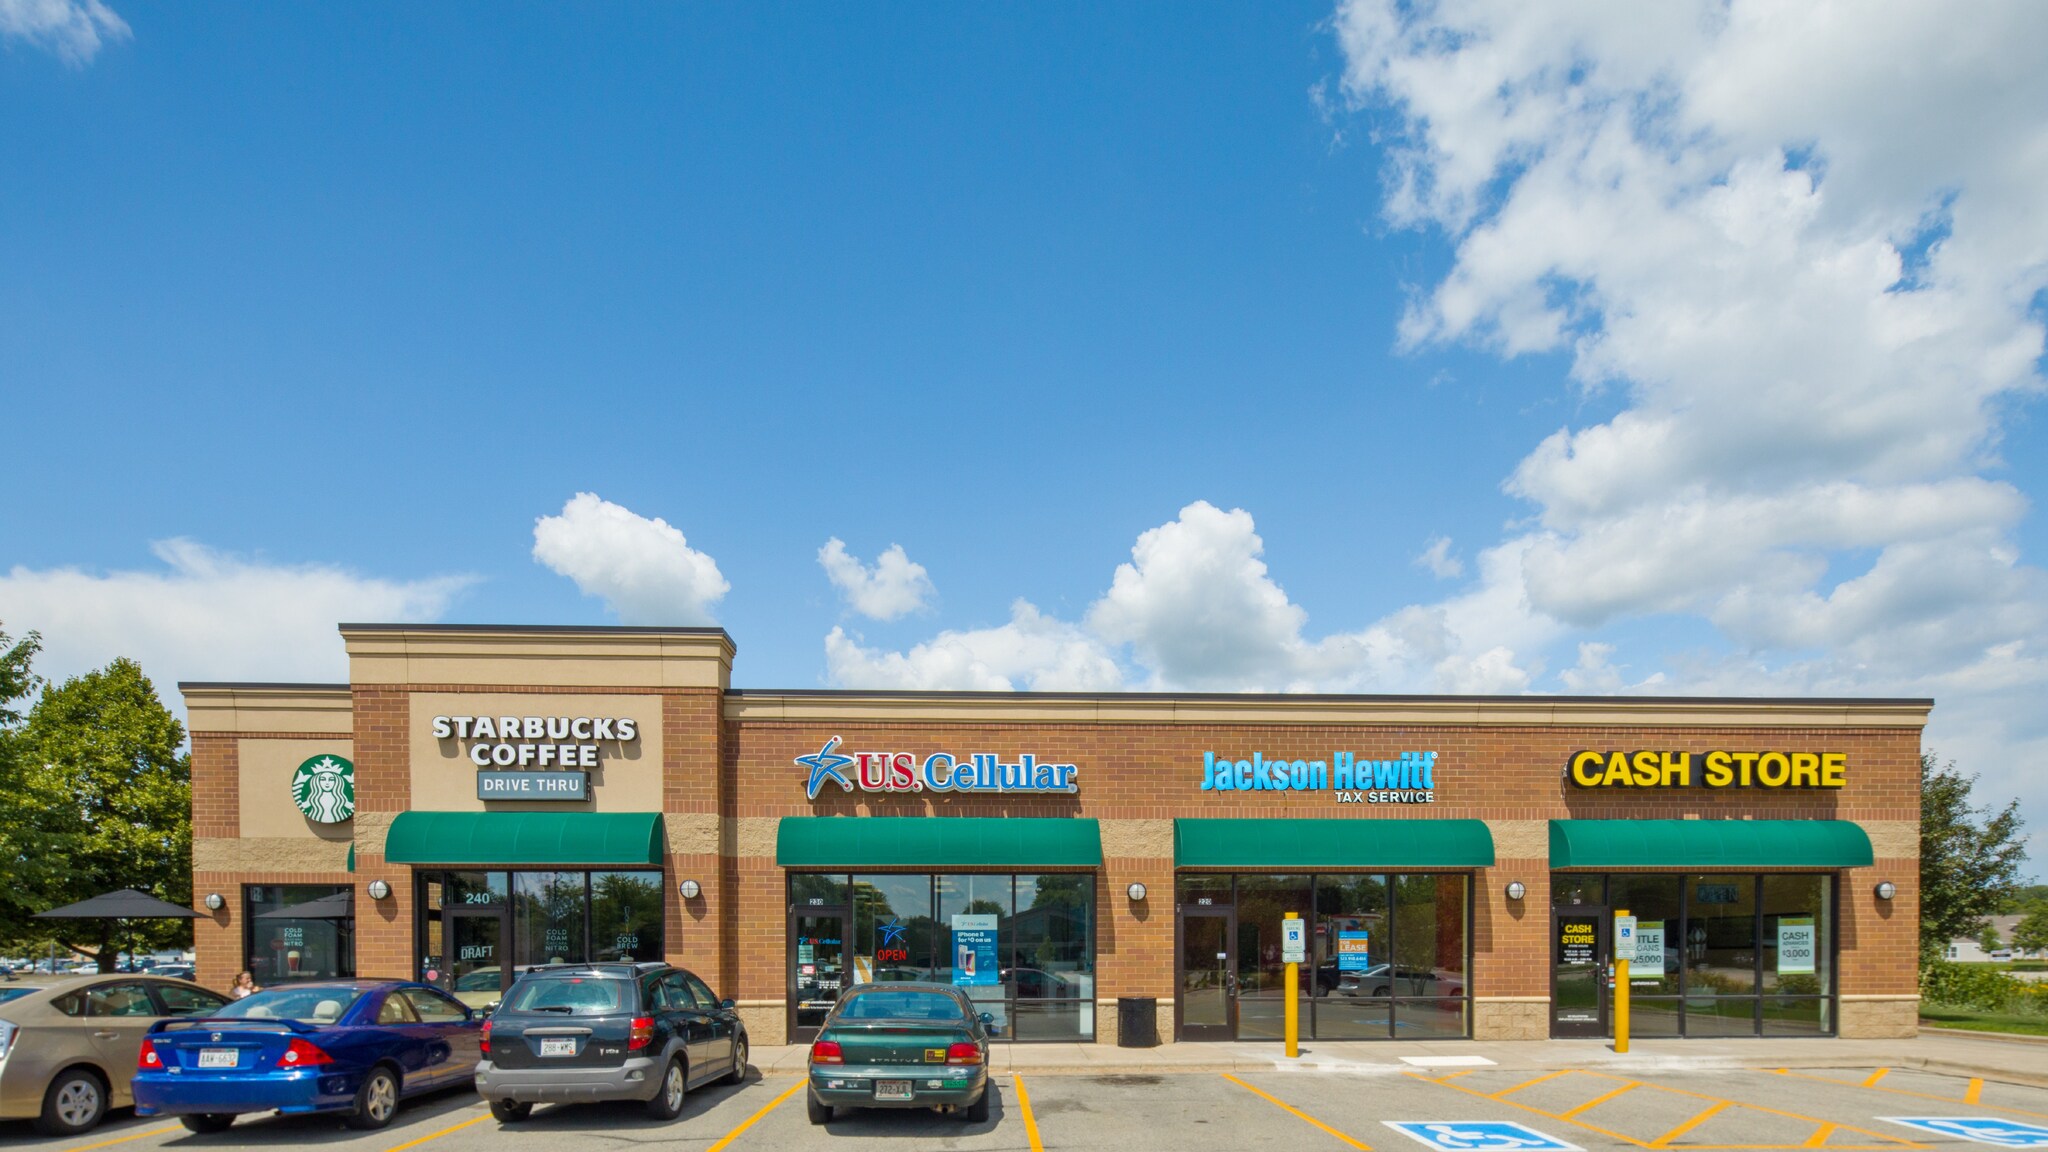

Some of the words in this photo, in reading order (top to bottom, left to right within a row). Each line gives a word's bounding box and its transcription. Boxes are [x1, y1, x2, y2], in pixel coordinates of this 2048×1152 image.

[432, 715, 637, 741] STARBUCKS
[470, 743, 598, 767] COFFEE
[855, 752, 922, 791] U.S.
[923, 752, 1078, 793] Cellular
[1200, 751, 1328, 791] Jackson
[1333, 751, 1435, 790] Hewitt
[1572, 750, 1691, 787] CASH
[1704, 750, 1847, 787] STORE
[483, 778, 530, 792] DRIVE
[536, 778, 580, 792] THRU
[1335, 791, 1363, 803] TAX
[1368, 791, 1435, 803] SERVICE
[465, 893, 490, 904] 240
[1564, 924, 1592, 934] CASH
[1561, 935, 1595, 944] STORE
[1636, 934, 1660, 944] ITLE
[1781, 931, 1809, 941] CASH
[461, 945, 494, 960] DRAFT
[1340, 944, 1367, 952] LEASE
[1636, 944, 1660, 952] OANS
[877, 949, 907, 961] OPEN
